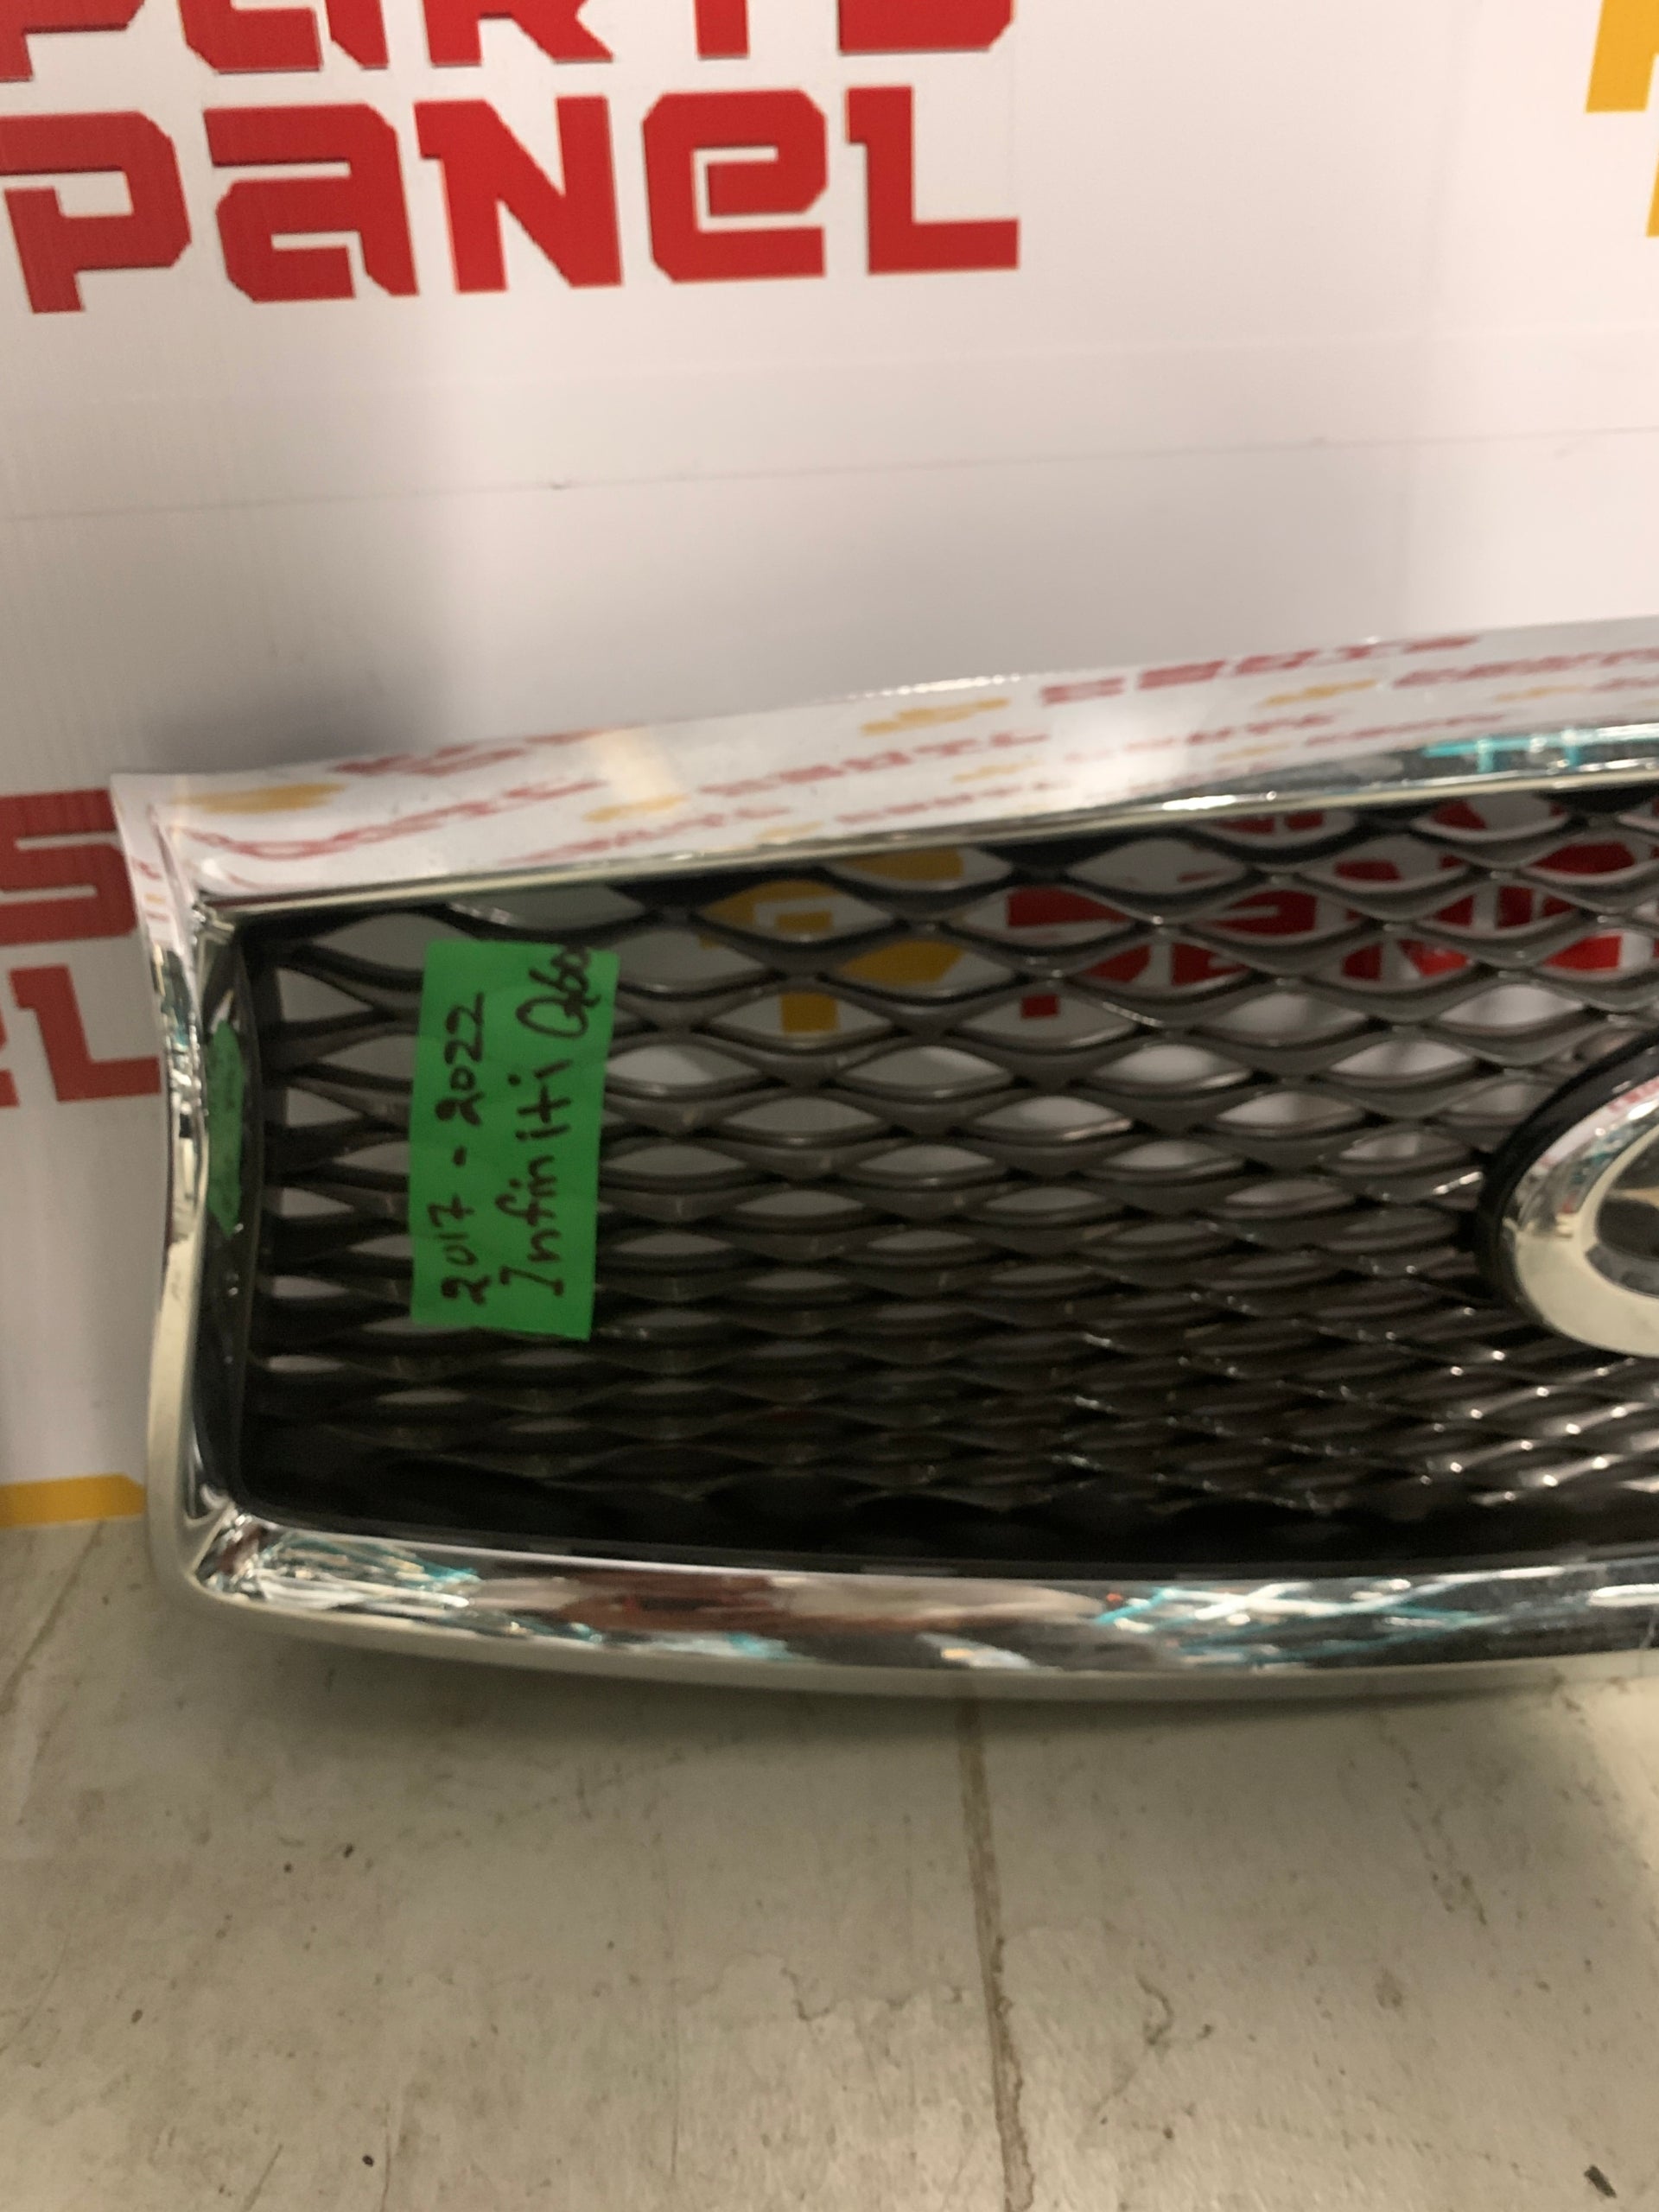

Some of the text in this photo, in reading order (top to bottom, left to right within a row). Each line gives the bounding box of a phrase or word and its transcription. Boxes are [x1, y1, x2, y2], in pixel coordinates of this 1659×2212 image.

[435, 991, 485, 1125] 2022
[495, 1059, 573, 1297] Infiniti
[428, 1193, 492, 1306] 2017
